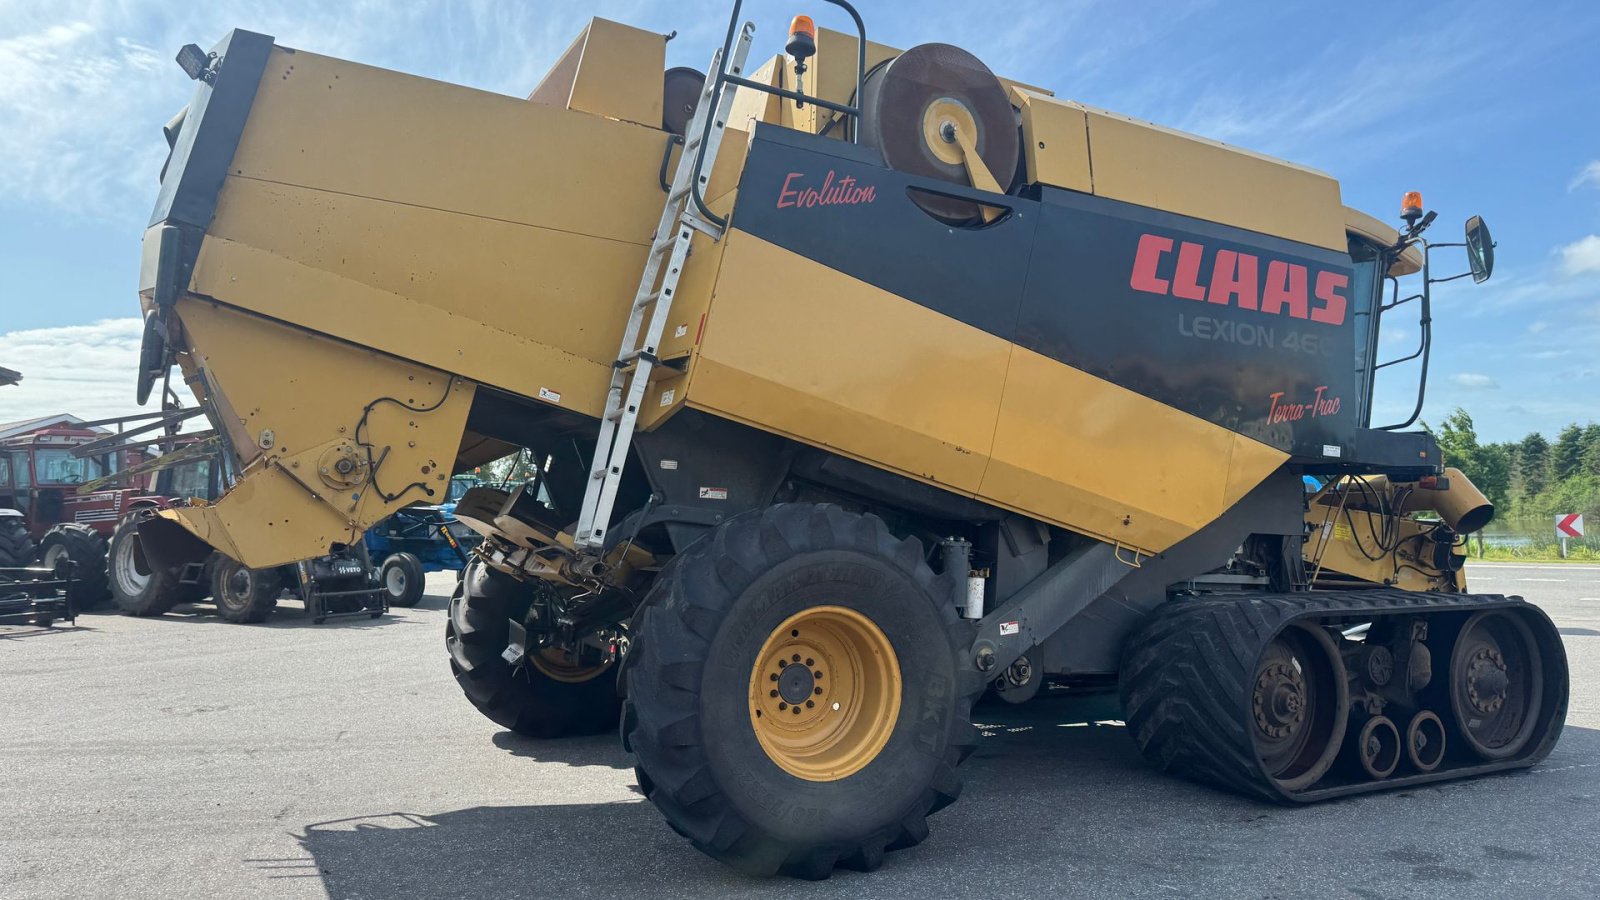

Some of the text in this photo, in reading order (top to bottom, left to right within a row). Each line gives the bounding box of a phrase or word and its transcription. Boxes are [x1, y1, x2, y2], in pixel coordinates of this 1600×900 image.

[776, 169, 875, 209] Evolution
[1130, 234, 1349, 326] CLAAS
[1178, 313, 1275, 348] LEXION
[1266, 386, 1341, 425] Terra-Trac
[918, 677, 948, 754] BKT
